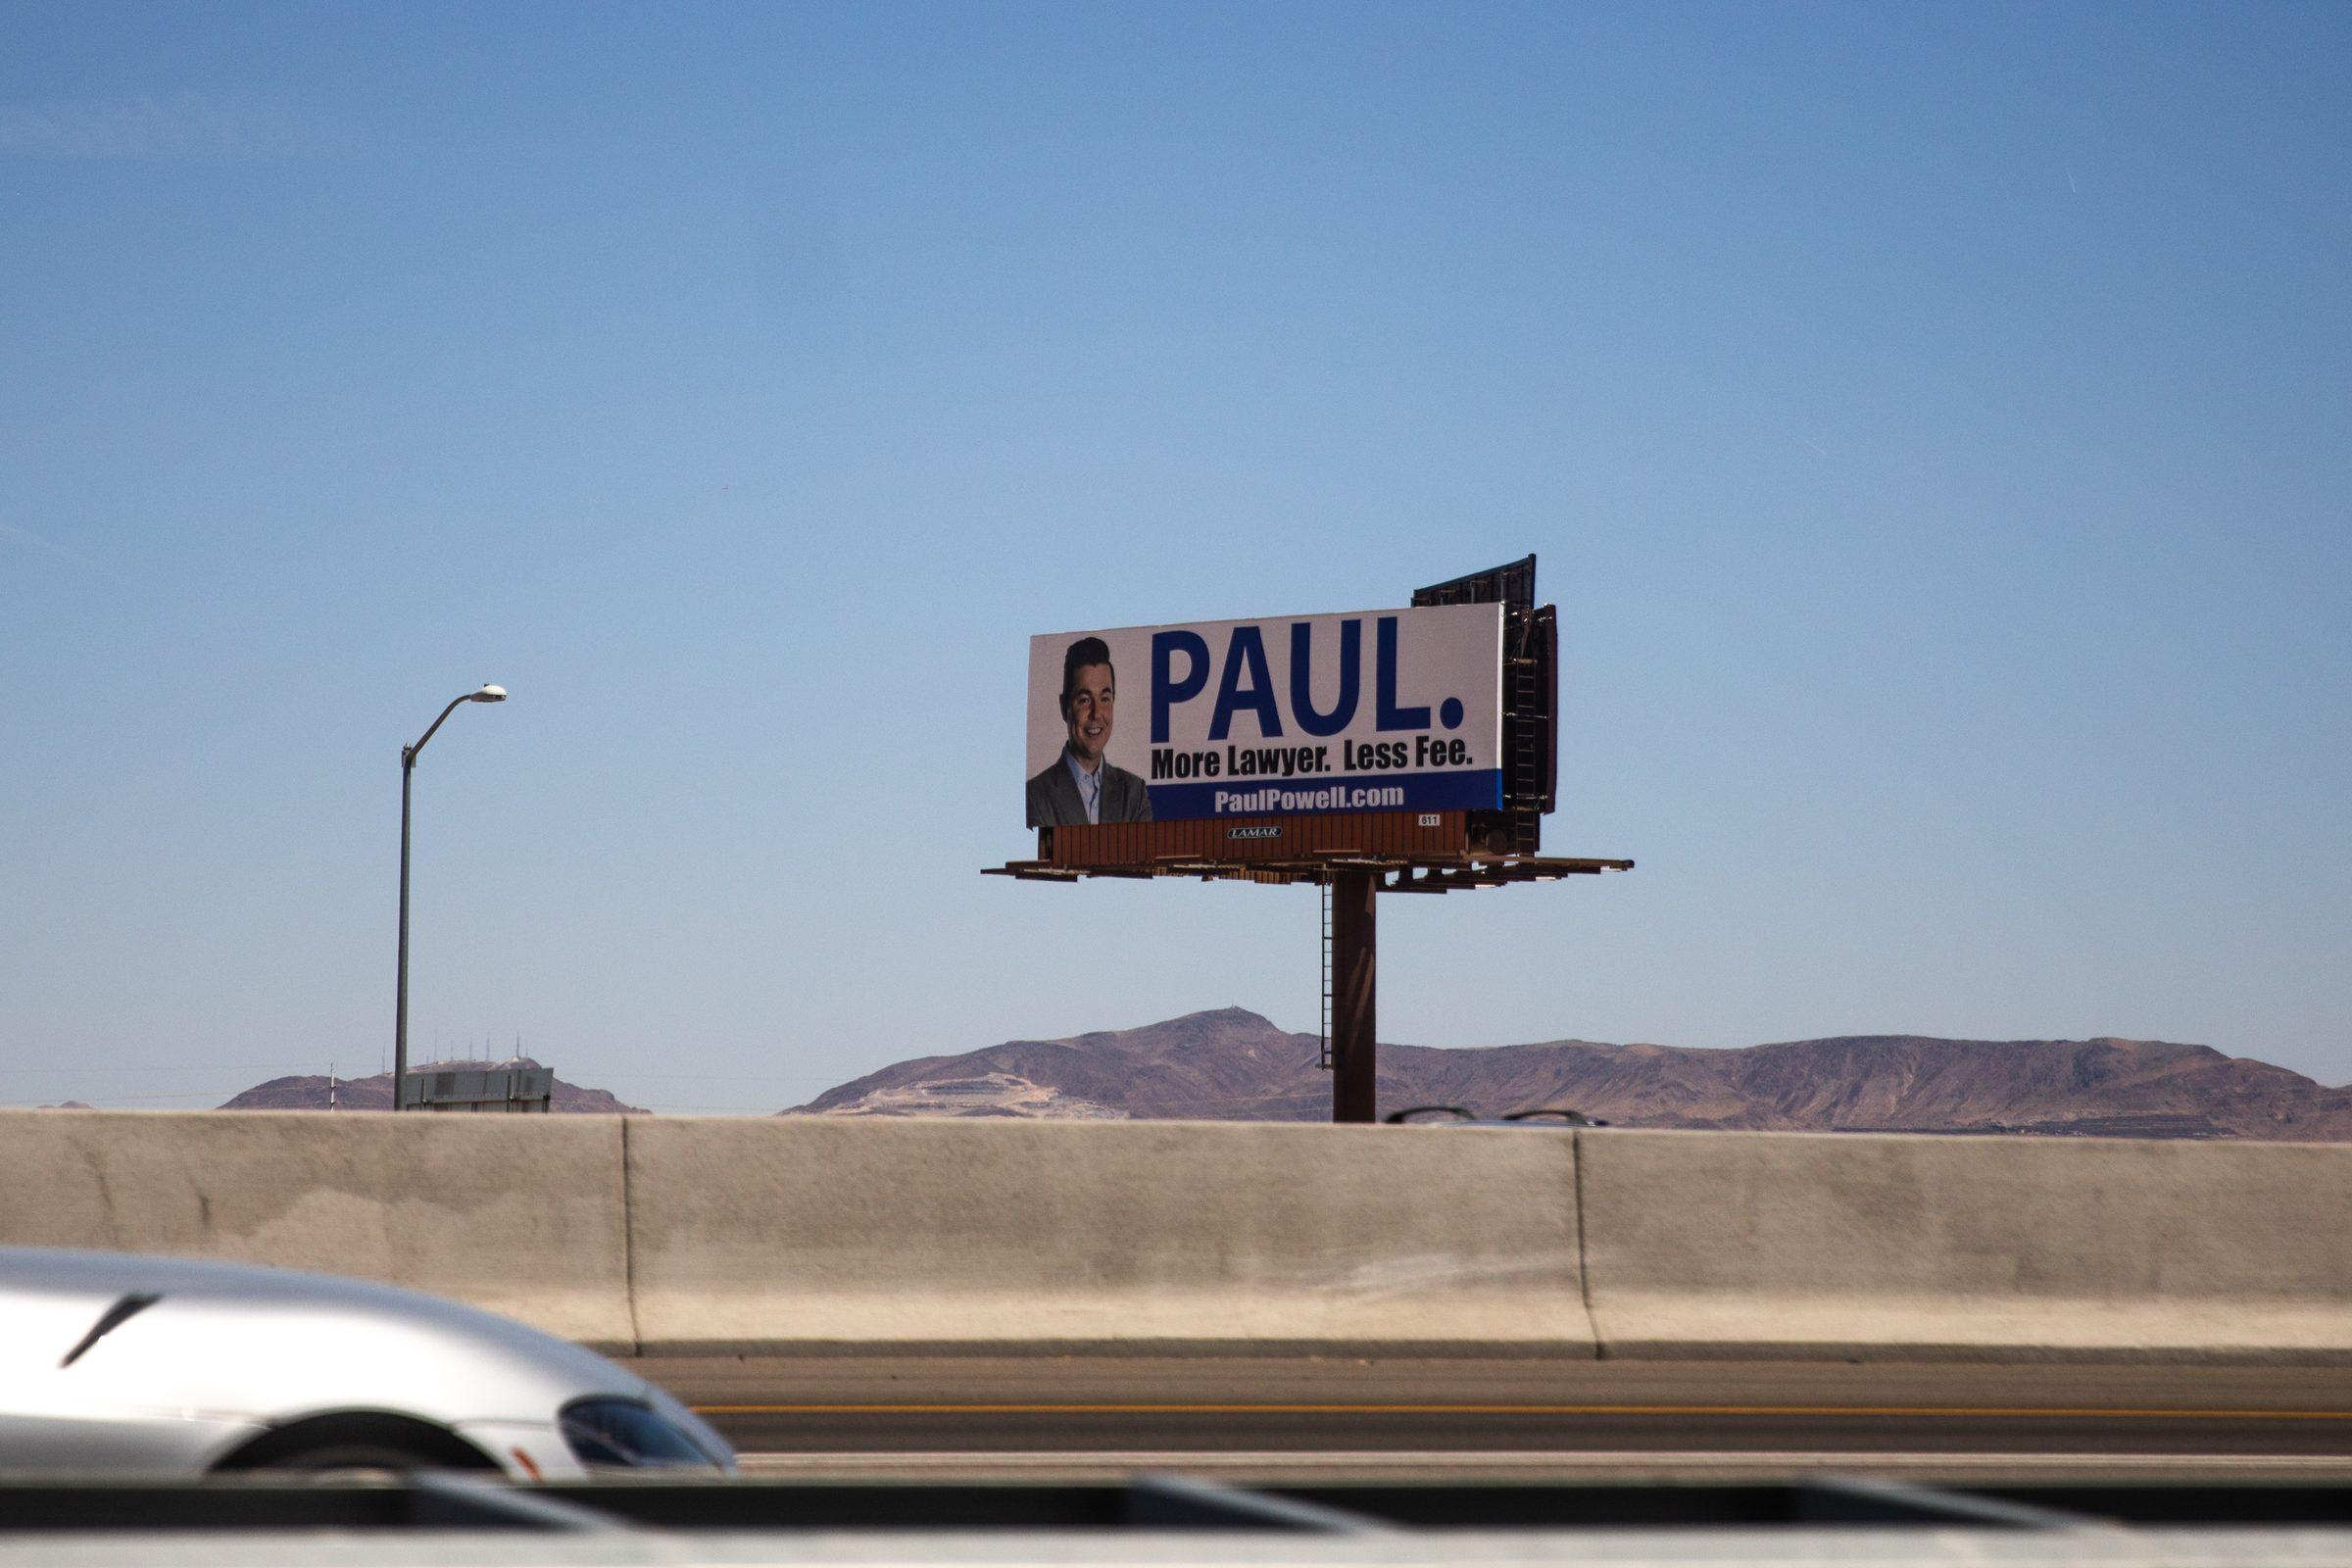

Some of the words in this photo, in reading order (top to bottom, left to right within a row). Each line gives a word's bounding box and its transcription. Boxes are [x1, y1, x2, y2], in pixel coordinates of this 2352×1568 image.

[1151, 616, 1464, 743] PAUL.
[1151, 748, 1220, 779] More
[1228, 744, 1331, 777] Lawyer.
[1344, 738, 1408, 770] Less
[1415, 735, 1473, 767] Fee.
[1214, 786, 1404, 812] PaulPowell.com
[1231, 827, 1278, 838] LAMAR
[1421, 814, 1438, 825] 611
